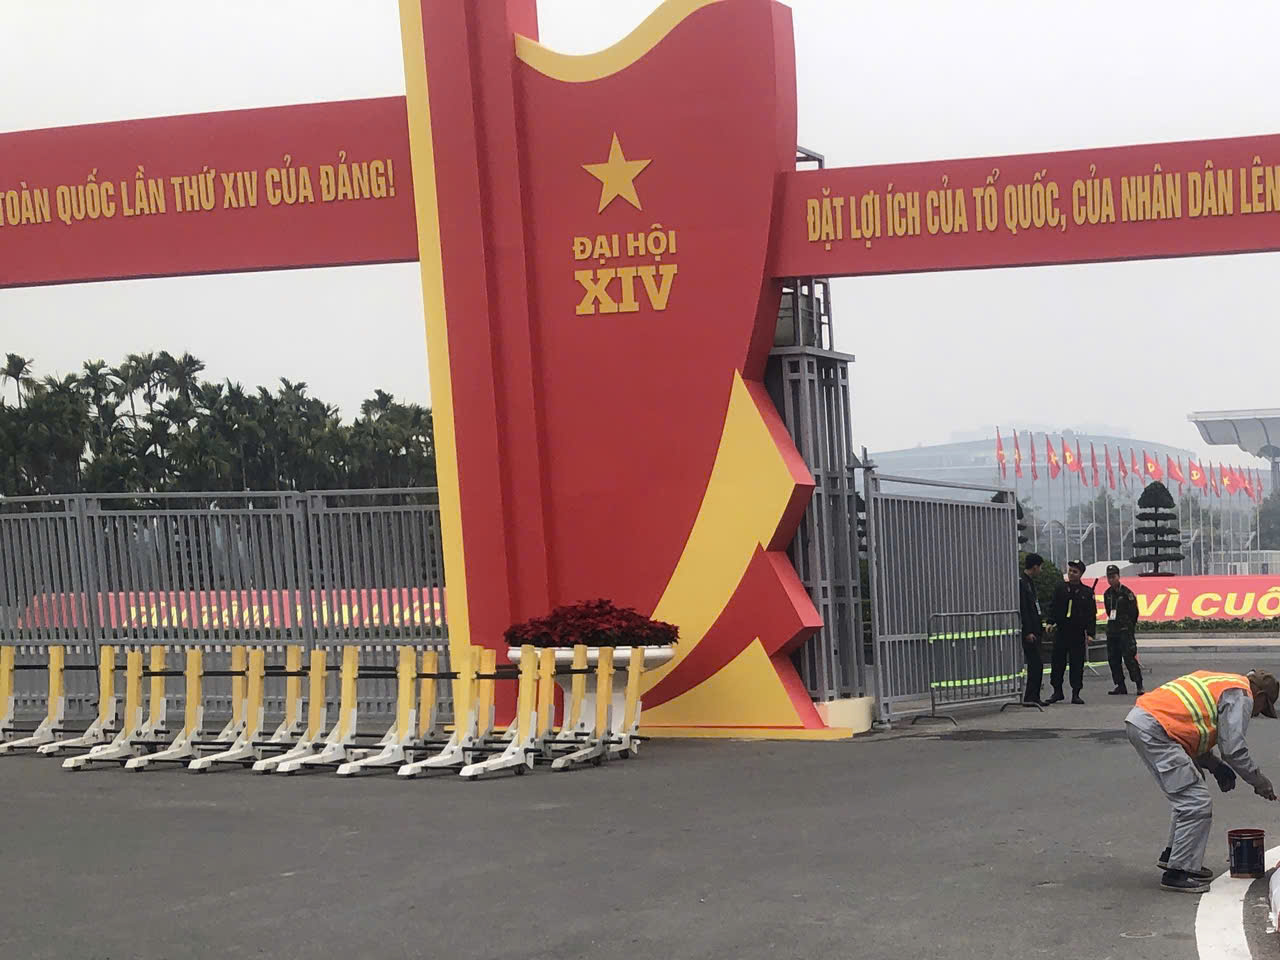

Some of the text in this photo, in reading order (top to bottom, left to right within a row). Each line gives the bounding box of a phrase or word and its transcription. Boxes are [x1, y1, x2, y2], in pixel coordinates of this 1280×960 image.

[56, 167, 116, 225] QUỐC
[121, 164, 167, 216] LẦN
[170, 165, 217, 212] THỨ
[220, 170, 259, 209] XIV
[265, 153, 315, 206] CỦA
[319, 149, 396, 203] ĐẢNG!
[806, 187, 845, 251] ĐẶT
[850, 189, 882, 249] LỢI
[886, 183, 921, 237] ÍCH
[926, 174, 969, 235] CỦA
[972, 168, 1000, 232] TỔ
[1004, 168, 1067, 234] QUỐC,
[1072, 163, 1116, 226] CỦA
[1121, 163, 1182, 223] NHÂN
[1187, 159, 1234, 218] DÂN
[572, 223, 677, 265] ĐẠI HỘI
[574, 263, 678, 316] XIV
[1138, 588, 1179, 617] VÌ
